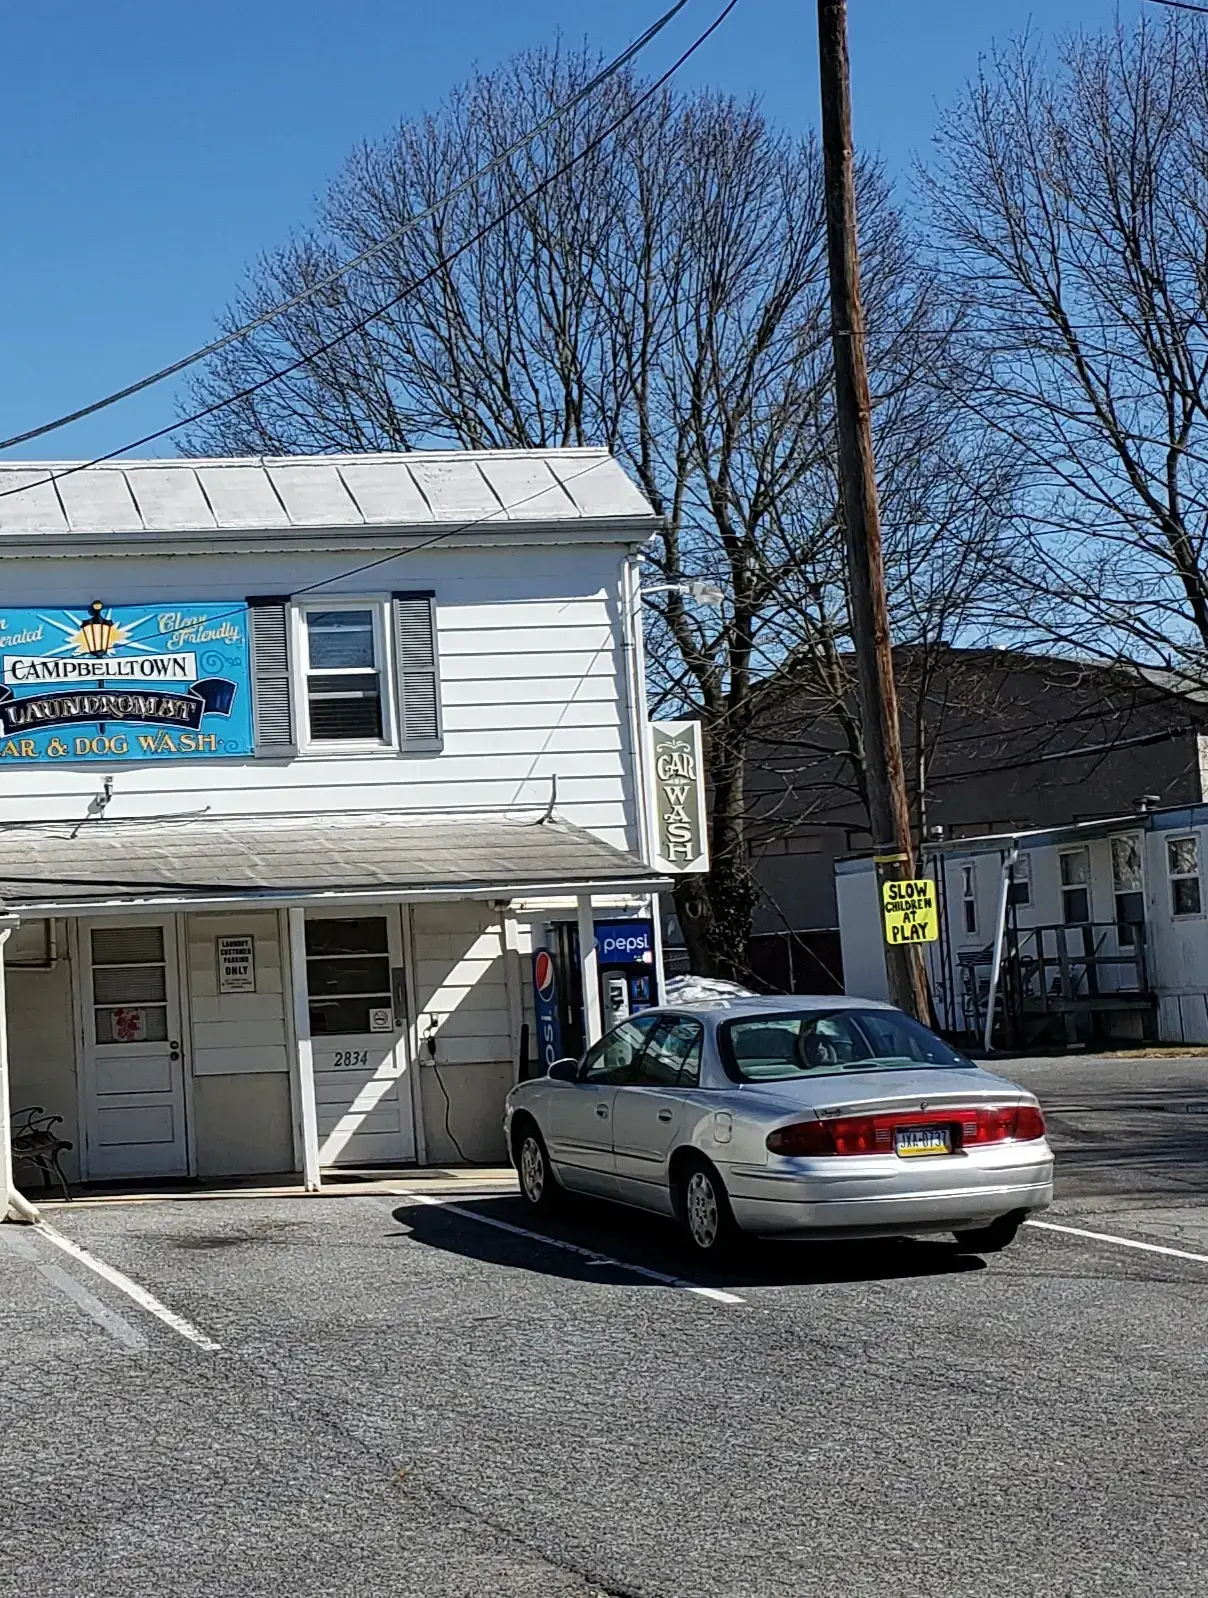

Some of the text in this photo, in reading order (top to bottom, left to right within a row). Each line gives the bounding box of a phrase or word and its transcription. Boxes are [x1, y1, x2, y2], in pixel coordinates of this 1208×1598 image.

[157, 612, 208, 633] Clean
[167, 622, 241, 650] Friendly
[10, 656, 188, 681] CAMPBELLTOWN
[5, 693, 196, 727] LAUNDROMAT
[47, 738, 68, 757] &
[75, 734, 129, 756] DOG
[138, 731, 217, 753] WASH
[656, 752, 696, 781] CAR
[663, 785, 694, 862] WASH
[888, 882, 928, 900] SLOW
[885, 898, 932, 913] CHILDREN
[902, 910, 917, 923] AT
[892, 922, 929, 942] PLAY
[604, 934, 650, 954] pepsi
[225, 966, 248, 975] ONLY
[334, 1051, 368, 1067] 2834
